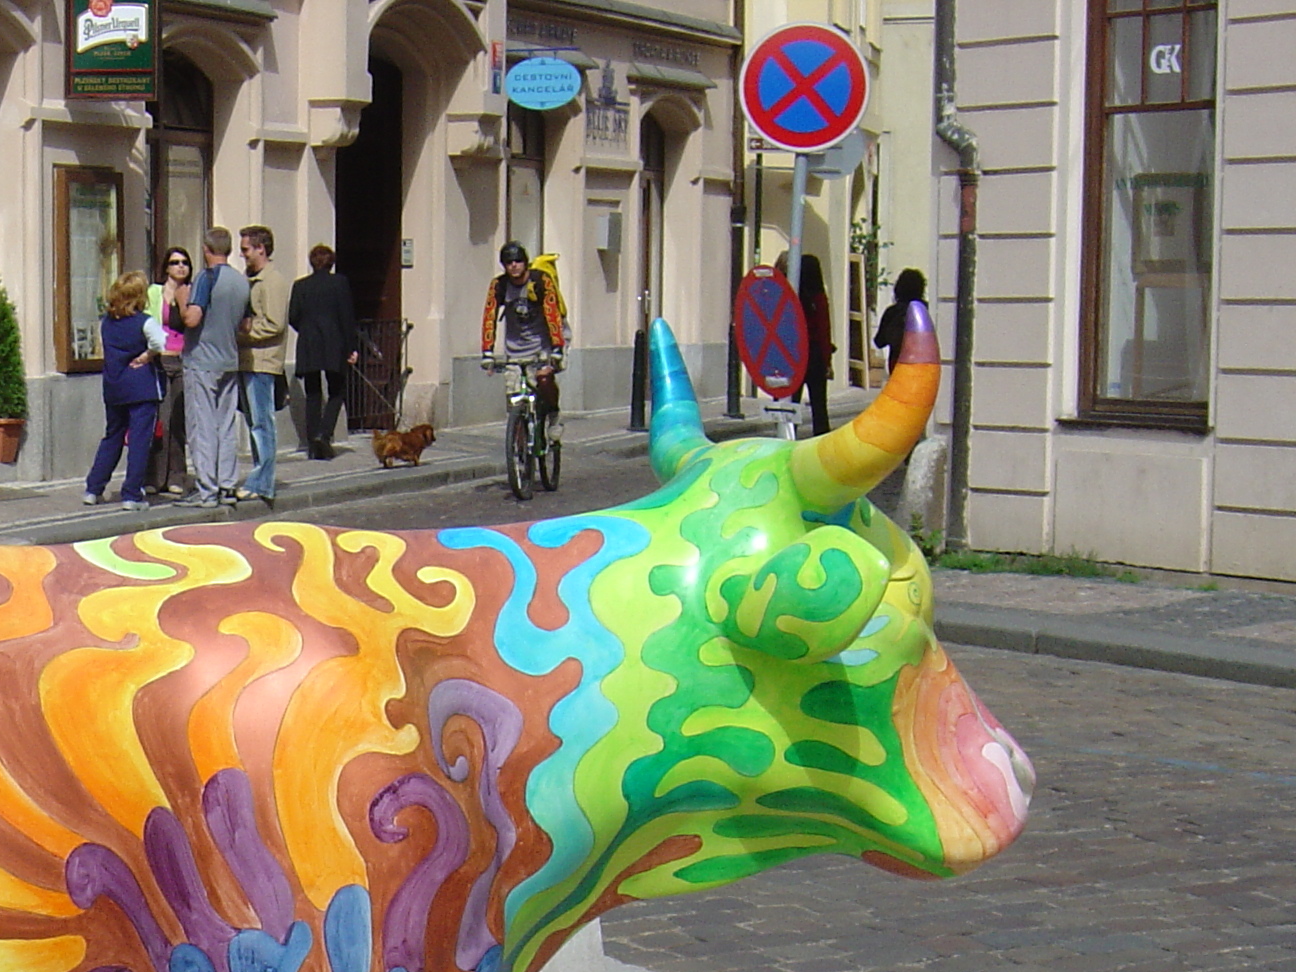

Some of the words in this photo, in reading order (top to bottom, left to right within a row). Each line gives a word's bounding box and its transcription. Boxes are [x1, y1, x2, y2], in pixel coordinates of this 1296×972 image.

[83, 18, 111, 41] Pilsner
[111, 17, 140, 31] Urquell
[514, 73, 572, 81] CESTOVNÍ
[512, 84, 574, 93] KANCELÁŘ
